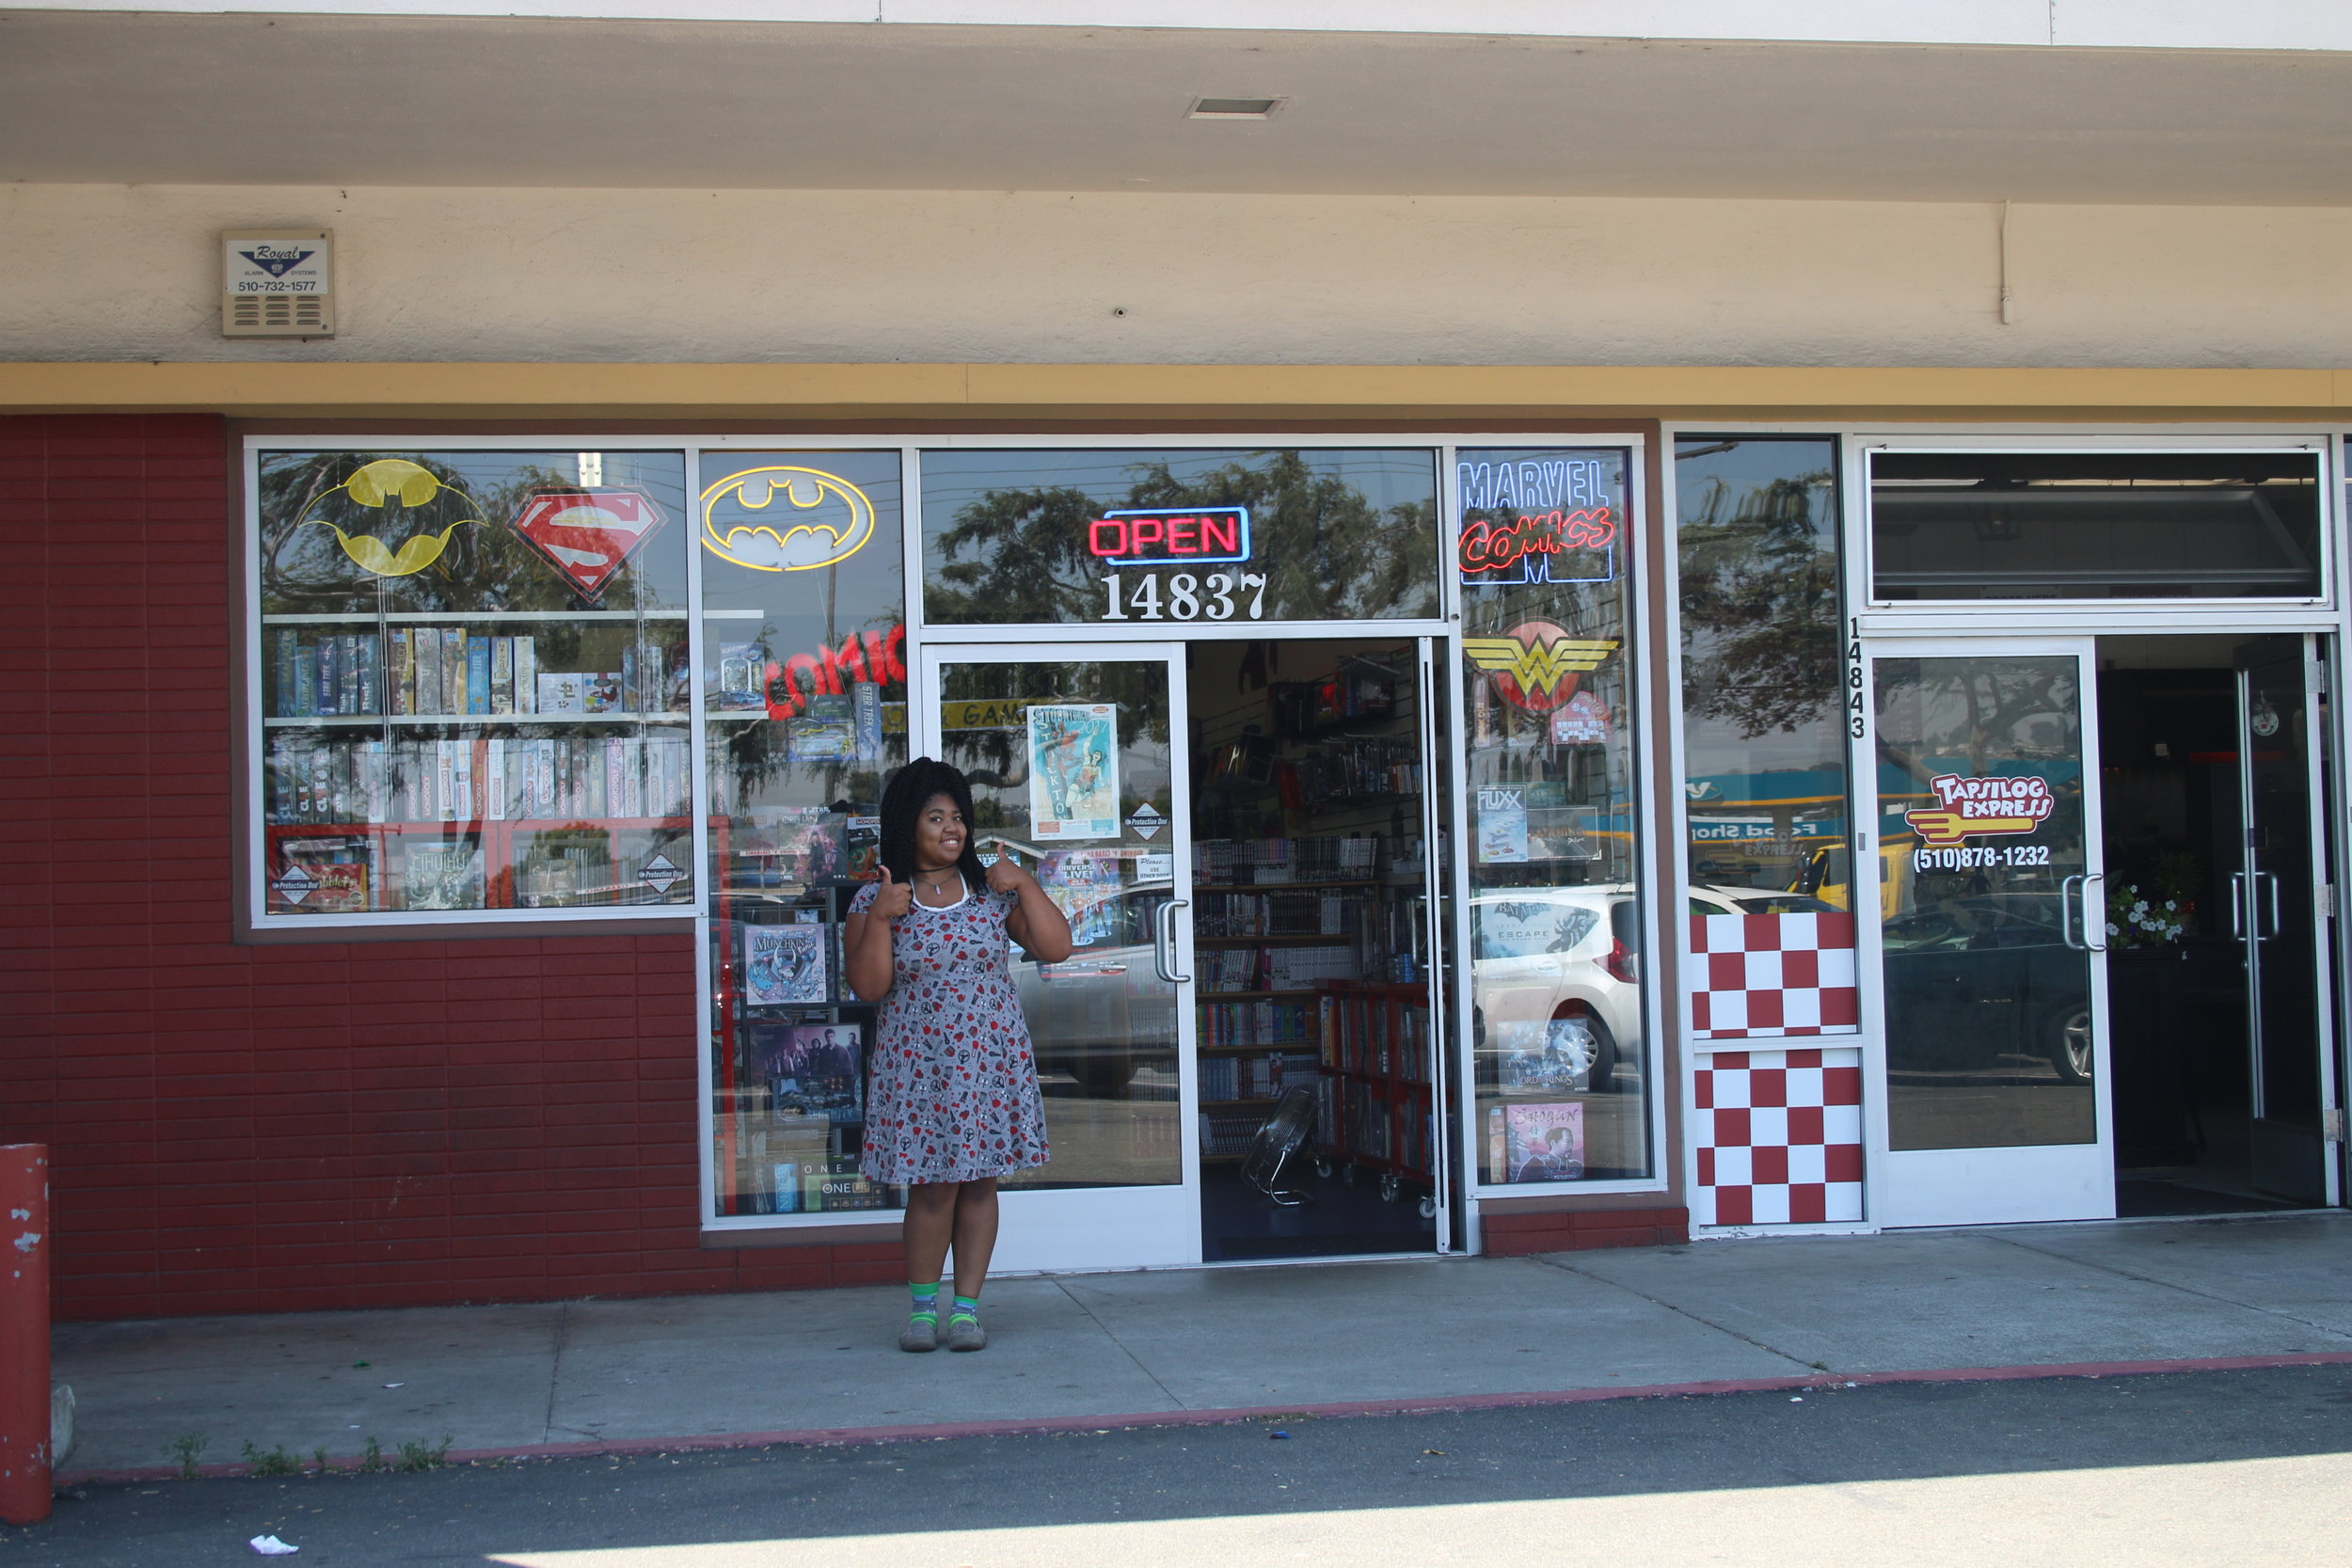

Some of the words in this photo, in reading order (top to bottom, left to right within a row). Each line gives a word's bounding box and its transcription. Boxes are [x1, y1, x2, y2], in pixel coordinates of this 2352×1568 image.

[257, 245, 298, 261] Royal
[239, 281, 316, 292] 510-732-1577
[1458, 461, 1610, 510] MARVEL
[1089, 517, 1236, 556] OPEN
[1101, 574, 1267, 620] 14837
[301, 662, 310, 711] AEROPLANES
[1849, 617, 1865, 738] 14843
[862, 686, 873, 706] STAR
[863, 707, 874, 728] TREK
[1076, 721, 1109, 734] 2017
[1935, 778, 2043, 805] TAPSILOG
[1963, 800, 2049, 817] EXPRESS
[1914, 847, 2049, 873] (510)878-1232
[1498, 930, 1549, 939] ESCAPE
[755, 937, 806, 951] MUNCHKIN
[797, 942, 815, 954] Panic
[804, 1164, 842, 1174] ONE
[822, 1183, 851, 1194] ONE
[852, 1182, 869, 1193] UP
